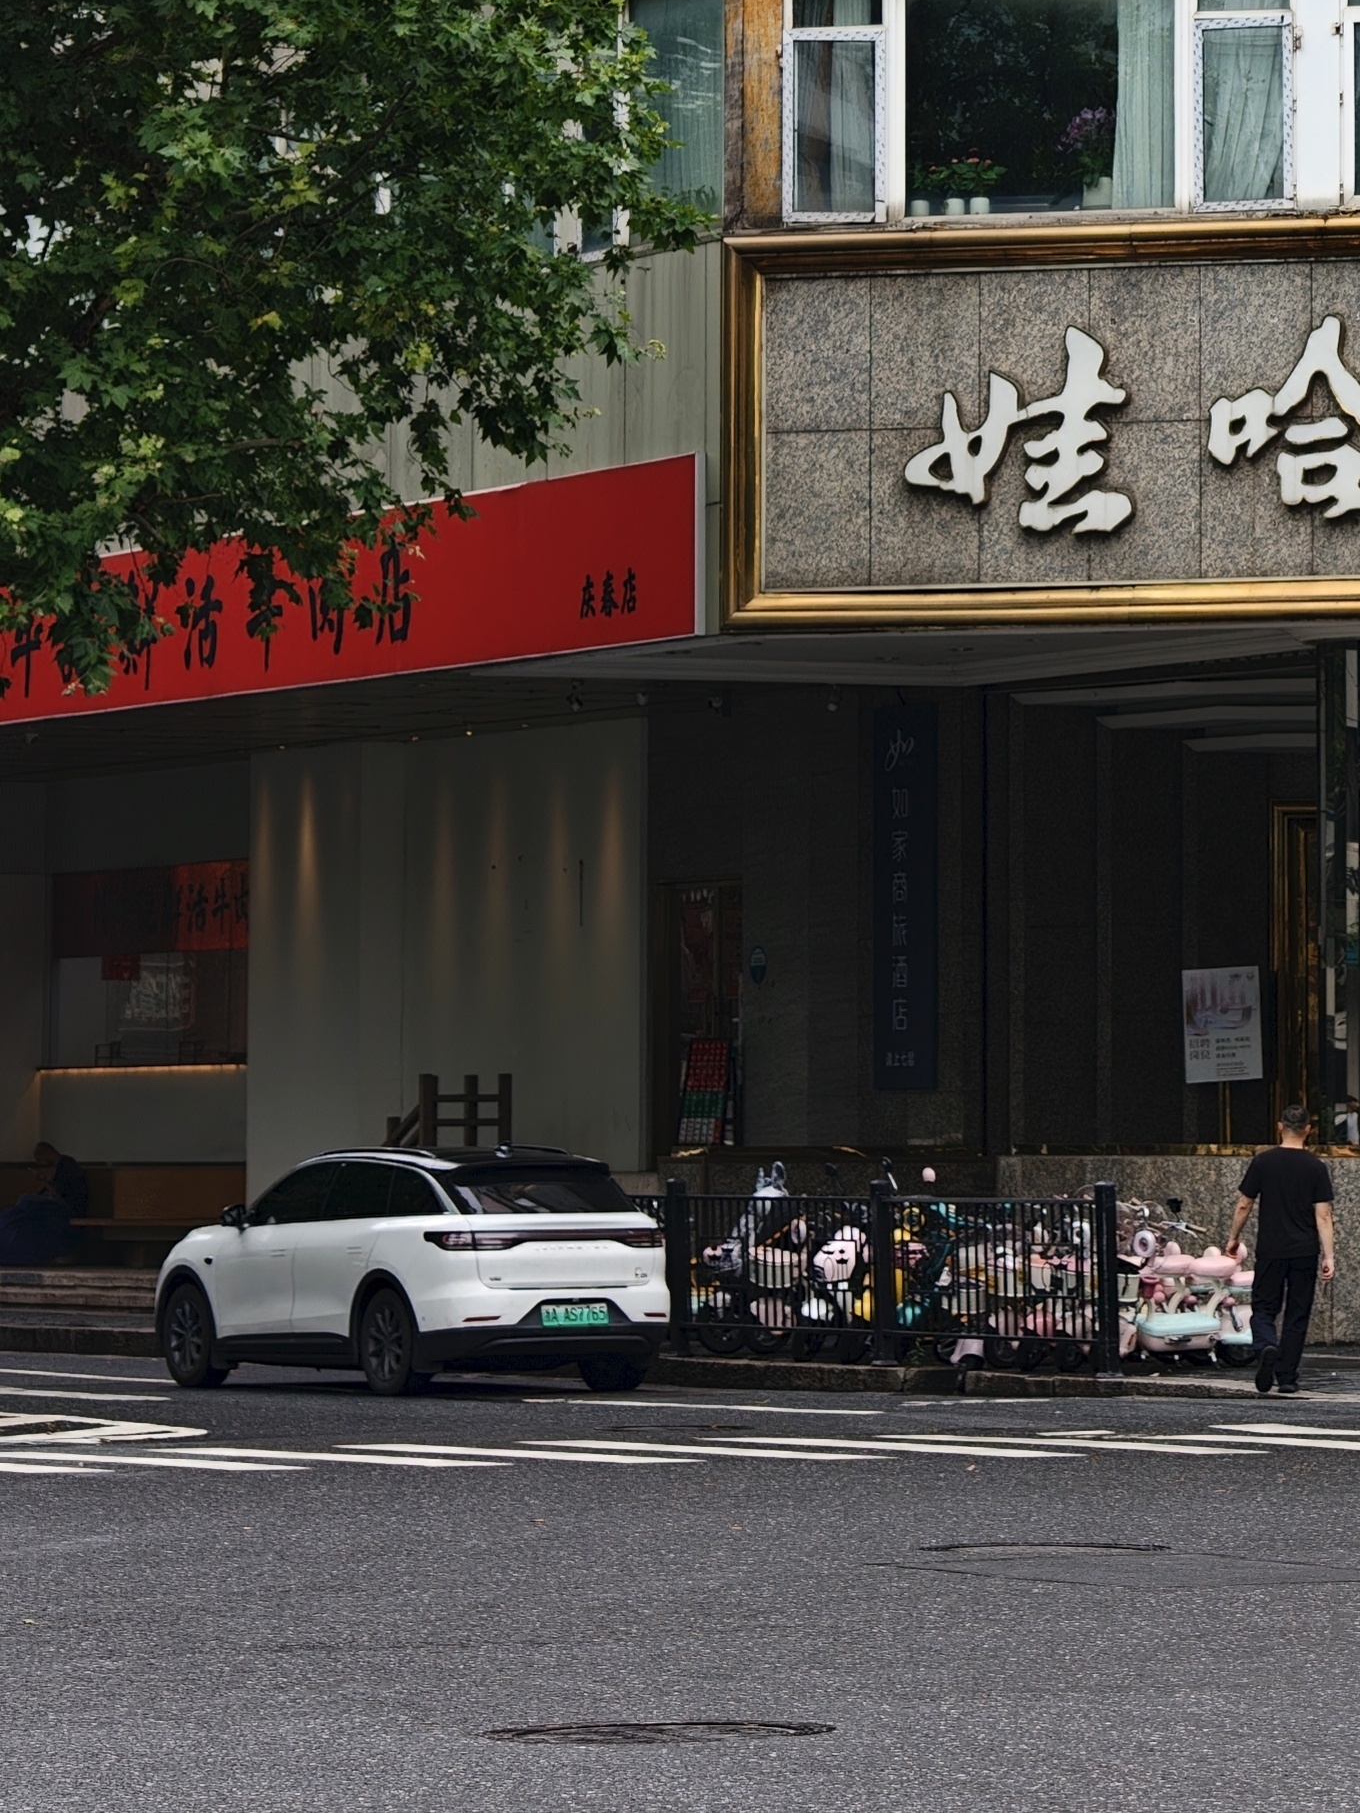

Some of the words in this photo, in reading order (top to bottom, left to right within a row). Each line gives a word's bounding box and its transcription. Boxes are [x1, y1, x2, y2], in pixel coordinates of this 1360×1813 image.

[891, 787, 909, 1031] 如家商旅酒店
